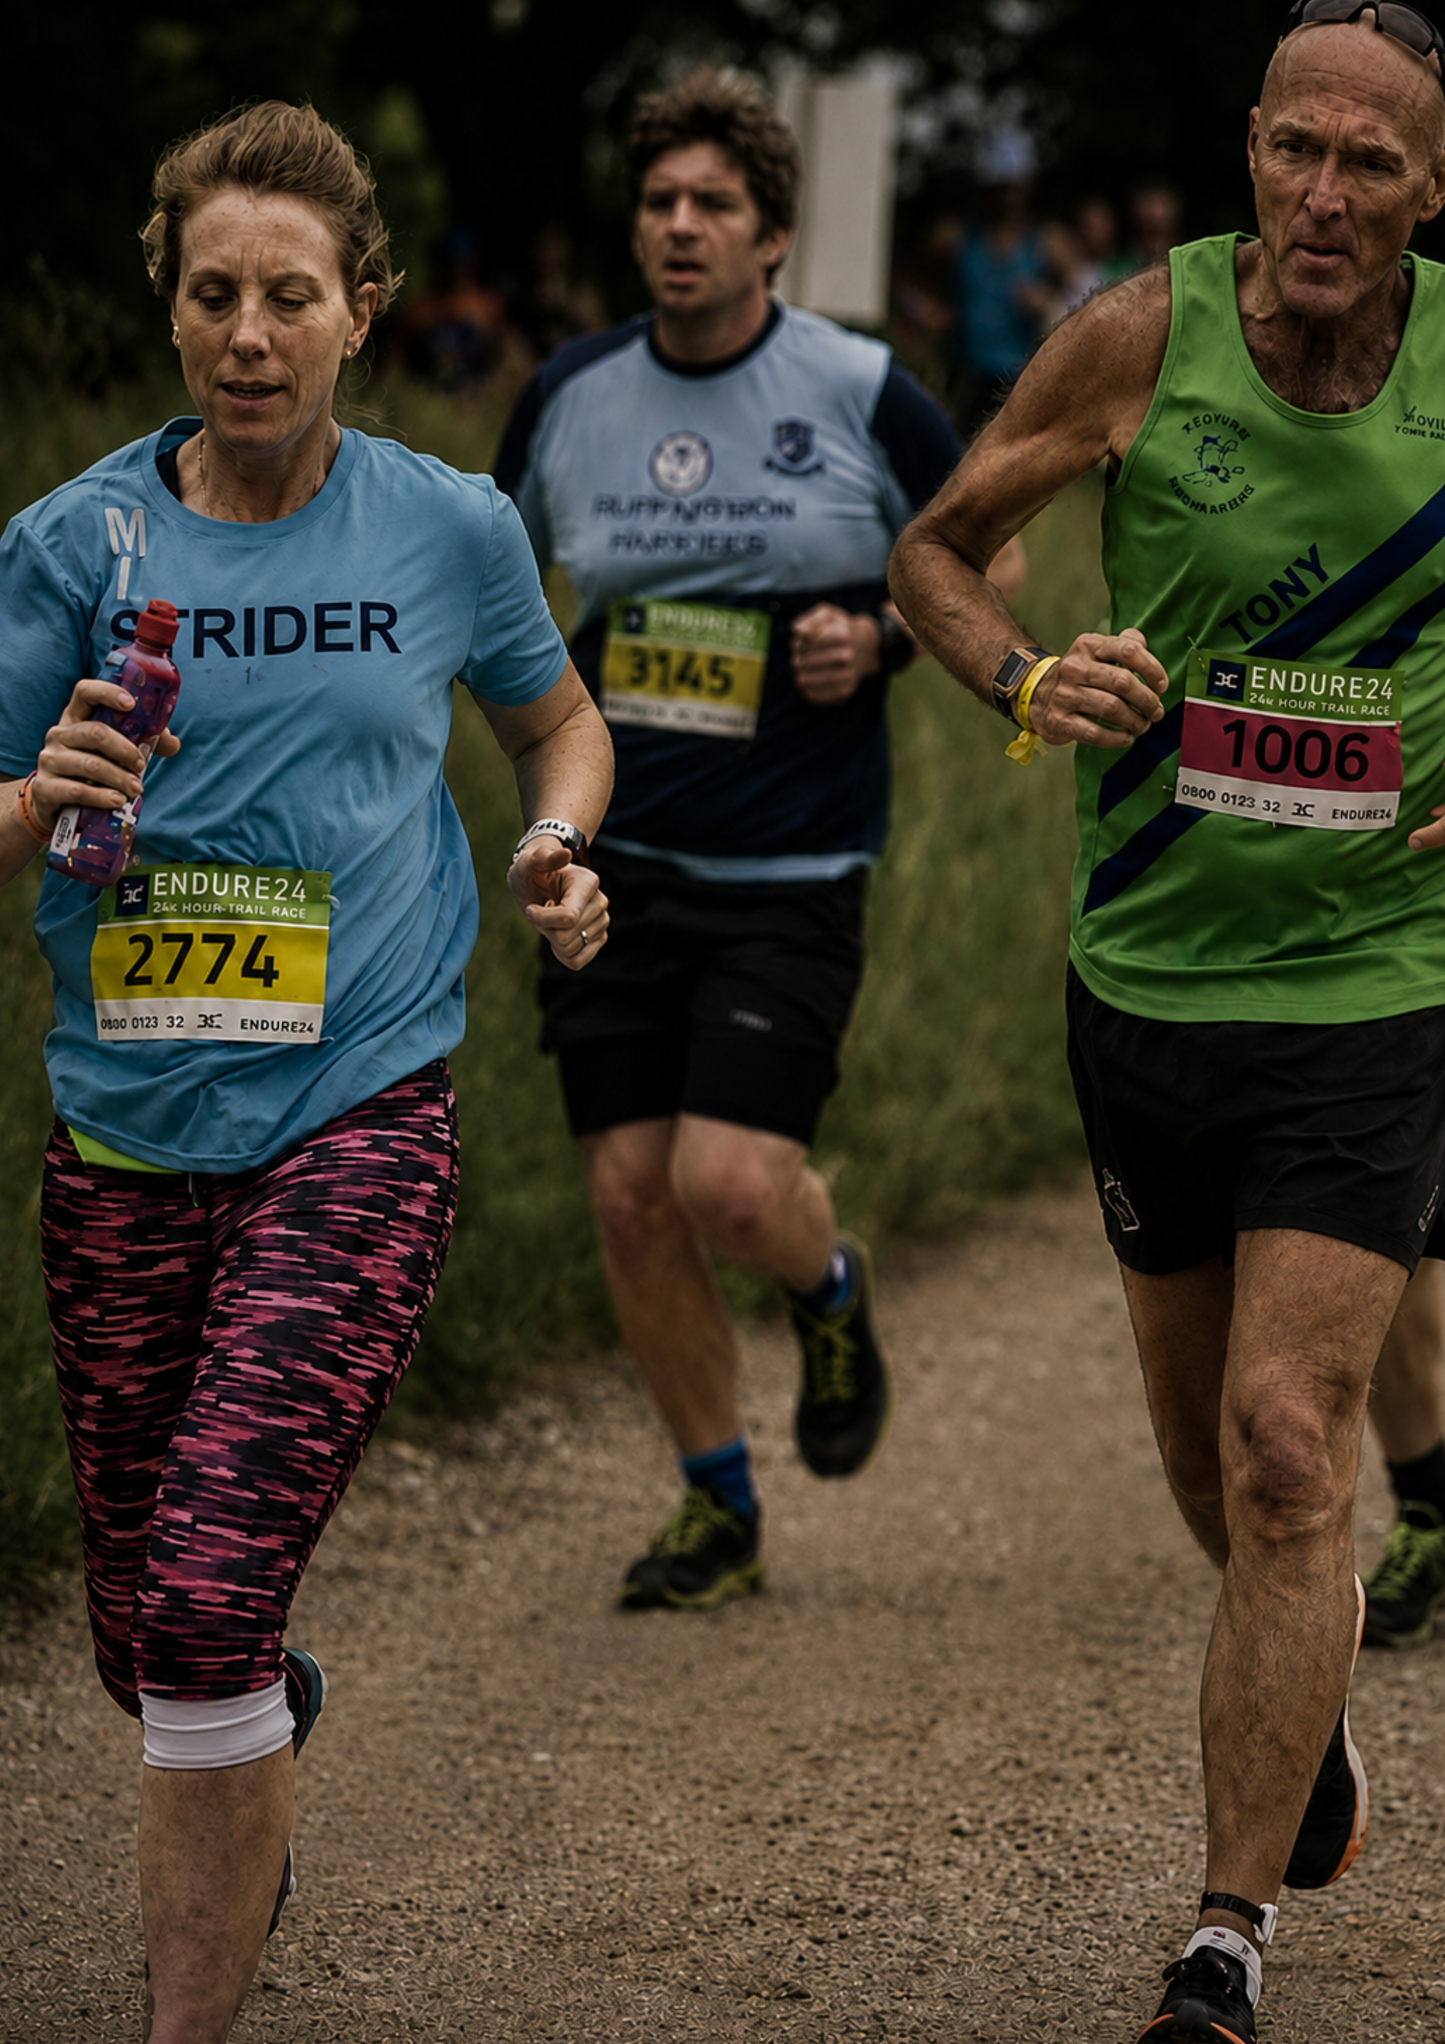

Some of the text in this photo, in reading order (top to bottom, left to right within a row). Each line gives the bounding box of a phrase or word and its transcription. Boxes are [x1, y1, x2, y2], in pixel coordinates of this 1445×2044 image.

[1218, 542, 1330, 645] TONY
[627, 646, 735, 698] 3145
[1251, 665, 1393, 700] ENDURE24
[1278, 698, 1316, 711] HOUR
[1321, 702, 1356, 715] TRAIL
[1361, 705, 1390, 716] RACE
[1223, 719, 1370, 782] 1006
[1182, 784, 1216, 801] 0800
[1221, 792, 1255, 808] 0123
[1262, 800, 1281, 813] 32
[153, 872, 307, 902] ENDURE24
[271, 907, 307, 919] RACE
[124, 933, 279, 988] 2774
[132, 1016, 158, 1028] 0123
[166, 1016, 184, 1028] 32
[240, 1018, 314, 1033] ENDURE24
